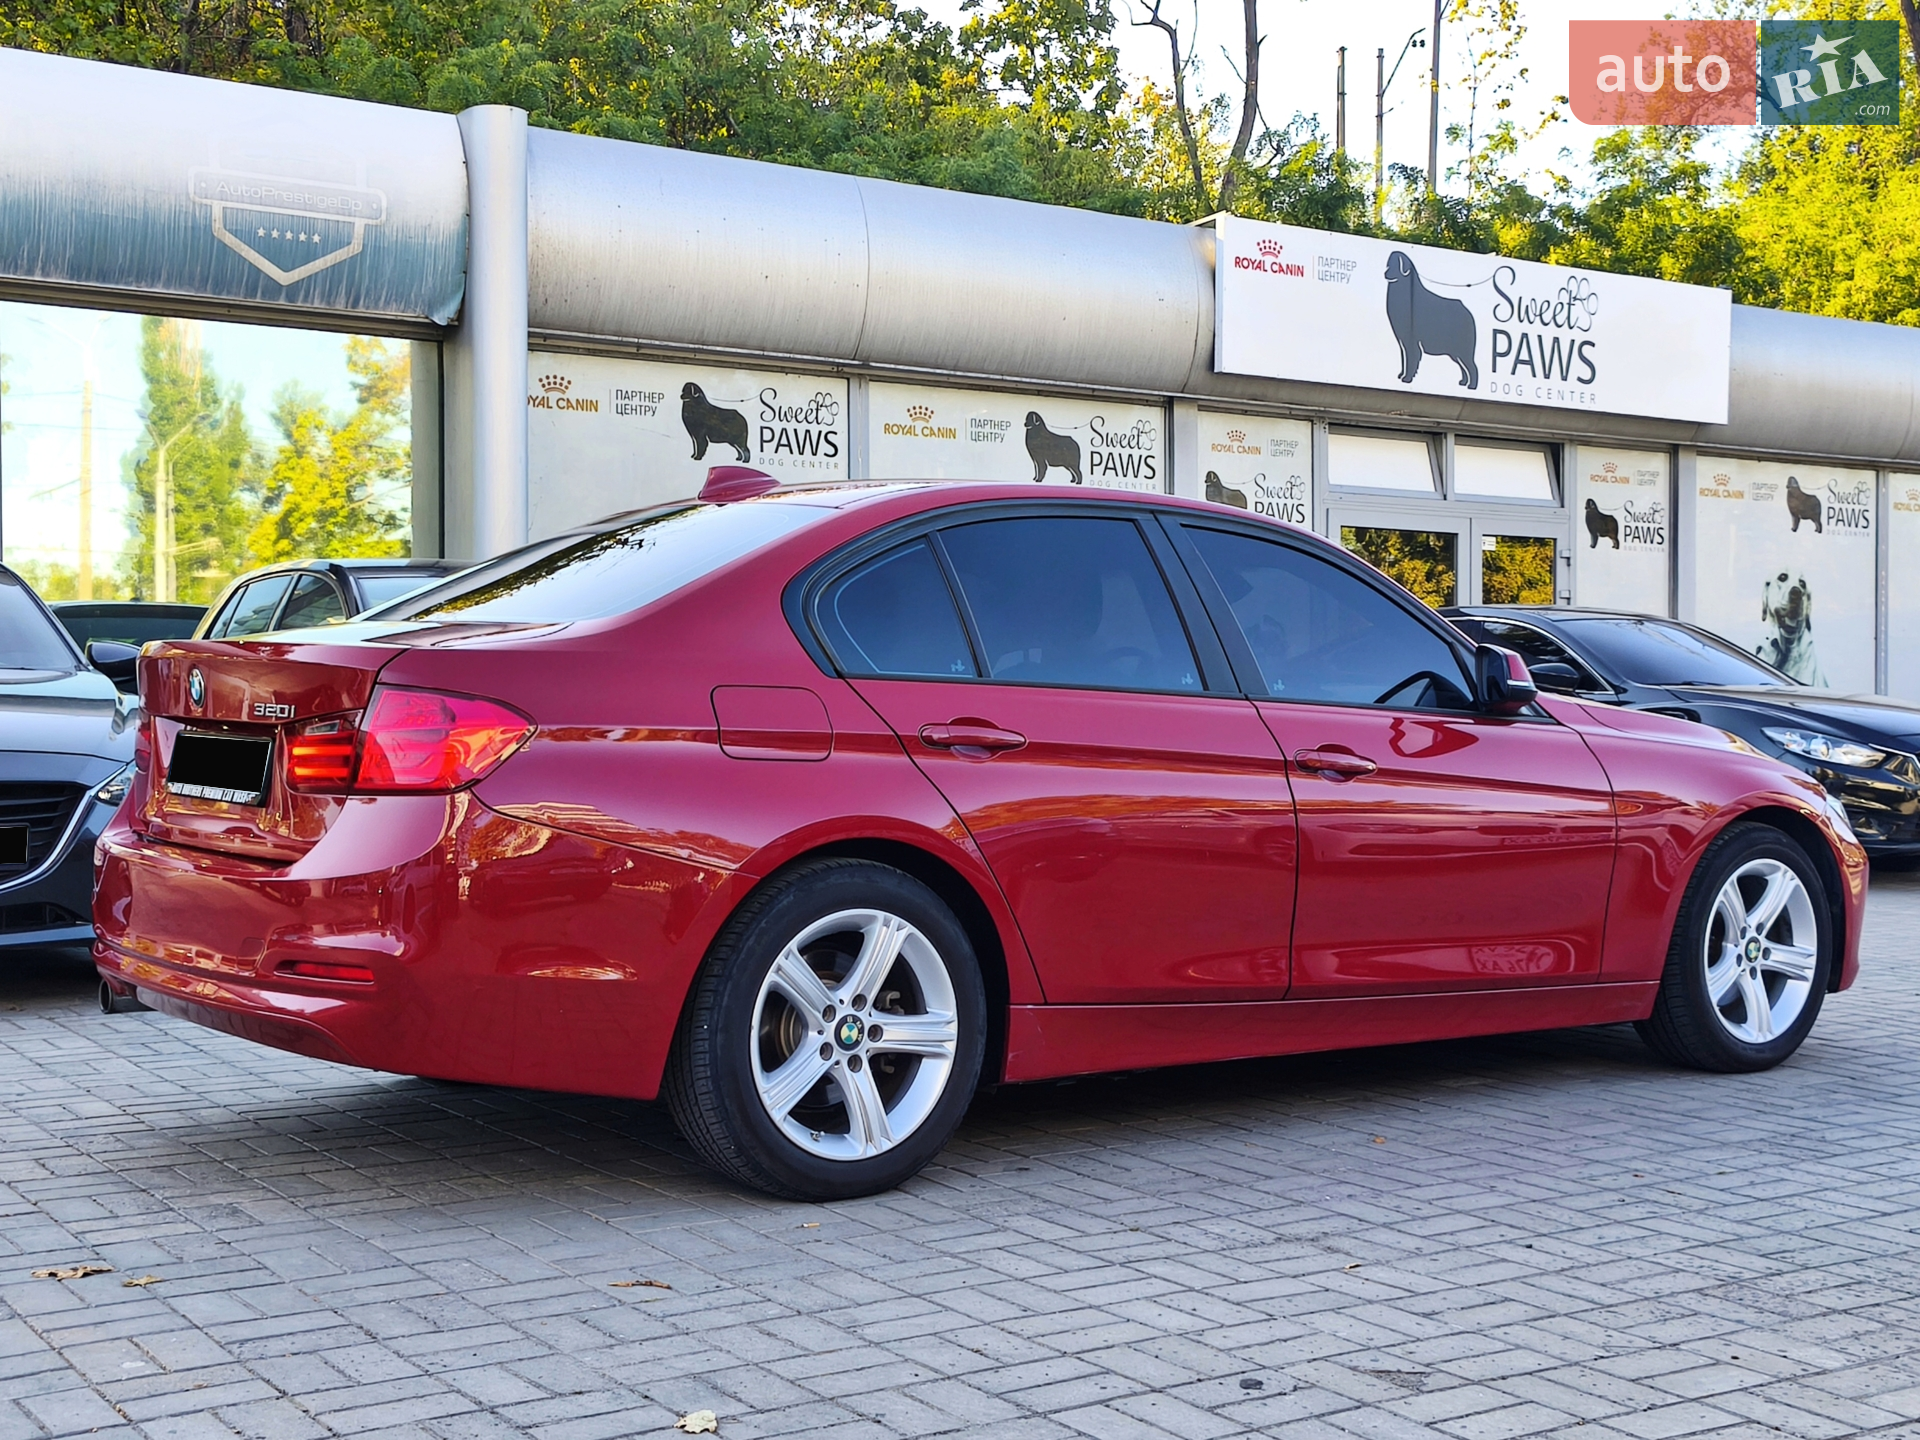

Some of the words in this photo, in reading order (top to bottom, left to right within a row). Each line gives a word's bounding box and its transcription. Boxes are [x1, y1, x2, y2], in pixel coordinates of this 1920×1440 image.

[216, 181, 363, 211] AutoPrestigeDp
[1234, 256, 1268, 273] ROYAL
[1270, 261, 1305, 278] CANIN
[1317, 255, 1358, 272] ПАРТНЕР
[1317, 269, 1351, 285] ЦЕНТРУ
[1492, 265, 1580, 330] Sweet
[1491, 328, 1597, 385] PAWS
[615, 389, 665, 404] ПАРТНЕР
[1490, 381, 1523, 397] DOG
[1535, 386, 1597, 405] CENTER
[555, 397, 599, 413] CANIN
[615, 403, 658, 417] ЦЕНТРУ
[759, 387, 825, 426] Sweet
[883, 422, 919, 437] ROYAL
[921, 425, 957, 440] CANIN
[970, 418, 1012, 431] ПАРТНЕР
[1089, 415, 1145, 450] Sweet
[760, 425, 839, 458] PAWS
[970, 430, 1006, 443] ЦЕНТРУ
[1211, 443, 1235, 453] ROYAL
[1236, 445, 1261, 455] CANIN
[759, 457, 784, 467] DOG
[792, 460, 839, 470] CENTER
[1090, 450, 1156, 480] PAWS
[1090, 479, 1111, 488] DOG
[1118, 481, 1157, 491] CENTER
[1254, 473, 1295, 500] Sweet
[1827, 478, 1861, 505] Sweet
[1254, 501, 1306, 524] PAWS
[1623, 500, 1658, 524] Sweet
[1827, 506, 1870, 529] PAWS
[1623, 525, 1665, 545] PAWS
